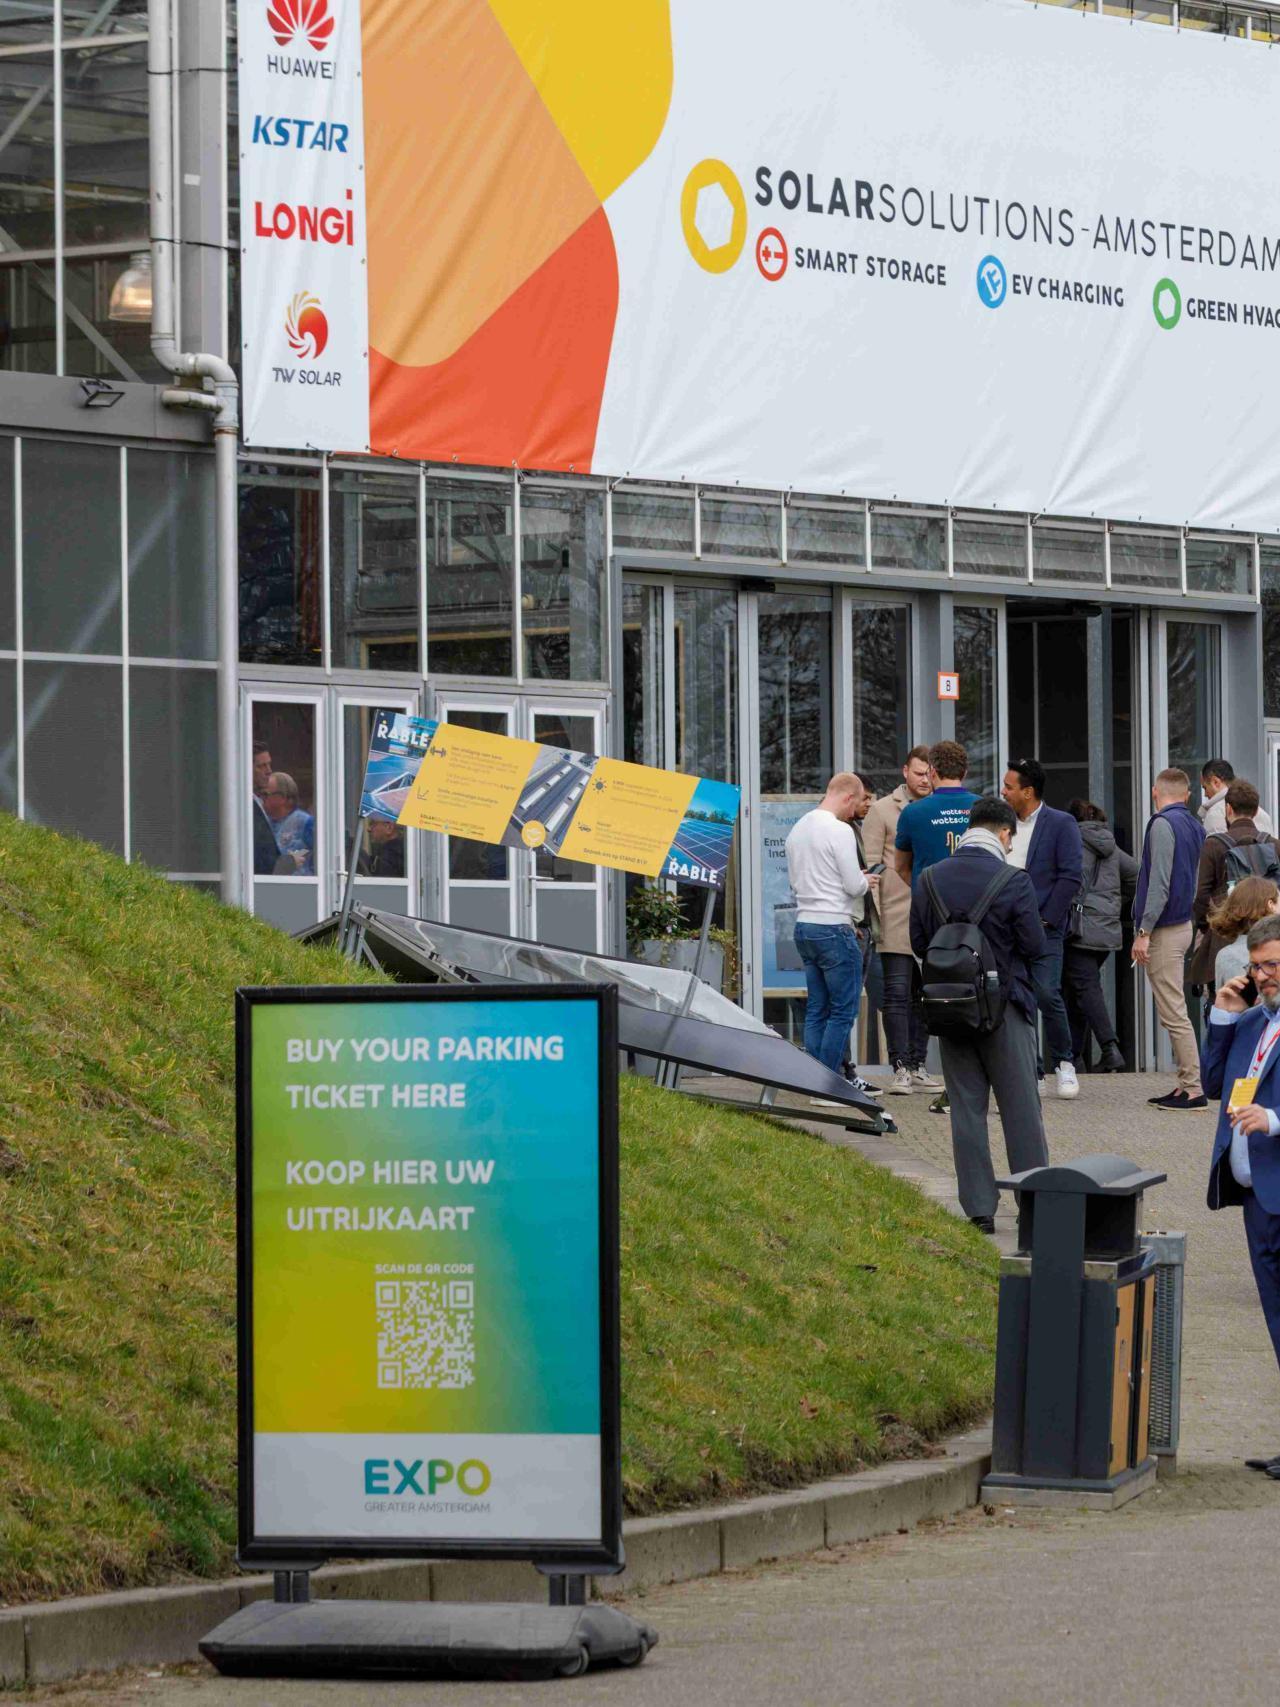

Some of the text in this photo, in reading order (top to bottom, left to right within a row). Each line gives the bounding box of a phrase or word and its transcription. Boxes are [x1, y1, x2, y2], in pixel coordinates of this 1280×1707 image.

[267, 54, 336, 79] HUAWEI
[252, 115, 348, 153] KSTAR
[795, 247, 947, 286] SMART STORAGE
[1013, 274, 1125, 307] EV CHARGING
[1186, 297, 1238, 323] GREEN
[272, 367, 342, 386] TW SOLAR
[286, 1036, 564, 1062] BUY YOUR PARKING
[286, 1083, 466, 1109] TICKET HERE
[286, 1159, 495, 1185] KOOP HIER UW
[287, 1206, 475, 1231] UITRIJKAART
[375, 1263, 474, 1275] SCAN DE QR CODE
[364, 1458, 492, 1496] EXPO
[364, 1502, 491, 1513] GREATER AMSTERDAM
